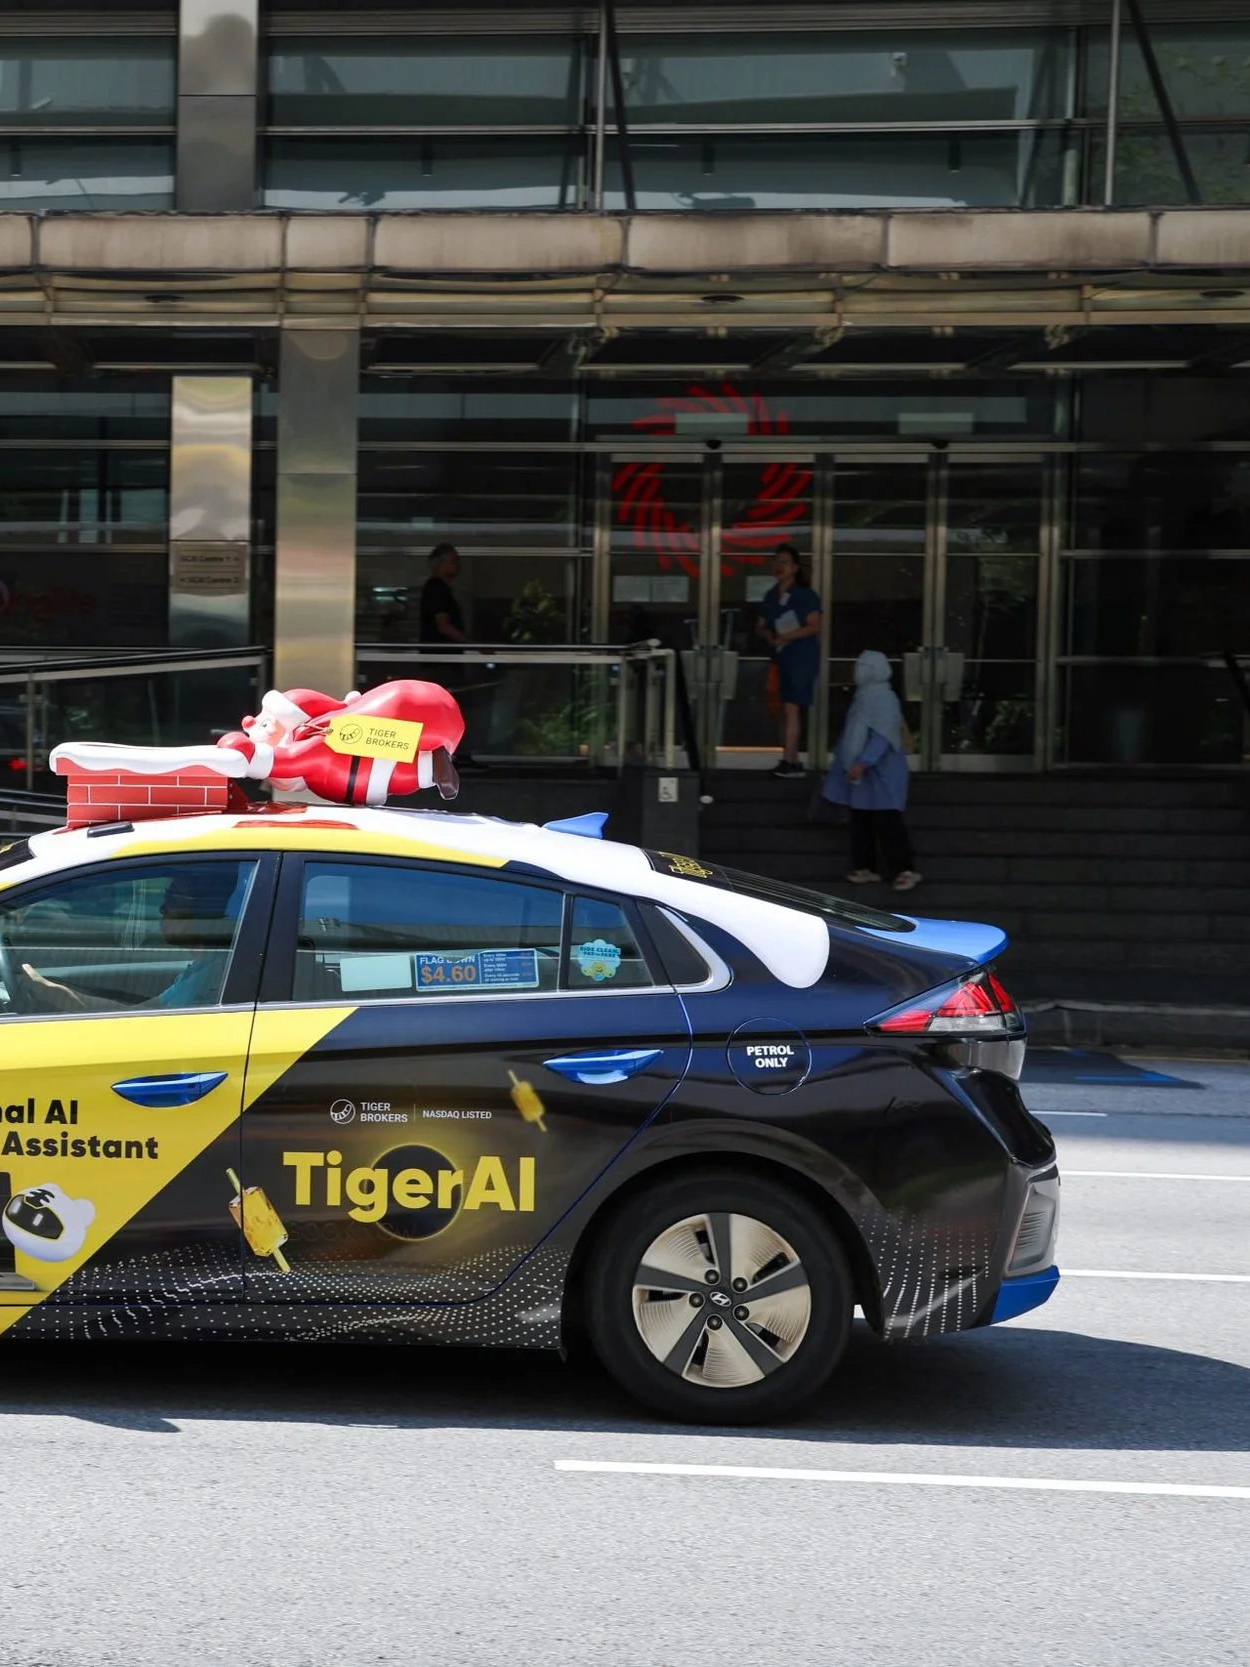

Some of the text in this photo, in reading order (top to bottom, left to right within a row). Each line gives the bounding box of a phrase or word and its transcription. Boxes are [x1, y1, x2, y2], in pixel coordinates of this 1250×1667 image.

[368, 728, 397, 739] TIGER
[365, 737, 410, 750] BROKERS
[419, 956, 445, 965] FLAG
[421, 964, 477, 984] $4.60
[746, 1045, 794, 1056] PETROL
[754, 1057, 789, 1069] ONLY
[44, 1099, 78, 1125] AI
[360, 1102, 391, 1111] TIGER
[360, 1113, 408, 1123] BROKERS
[422, 1110, 492, 1120] NASDAQ LISTED
[2, 1131, 159, 1160] Assistant
[282, 1150, 535, 1224] TigerAI
